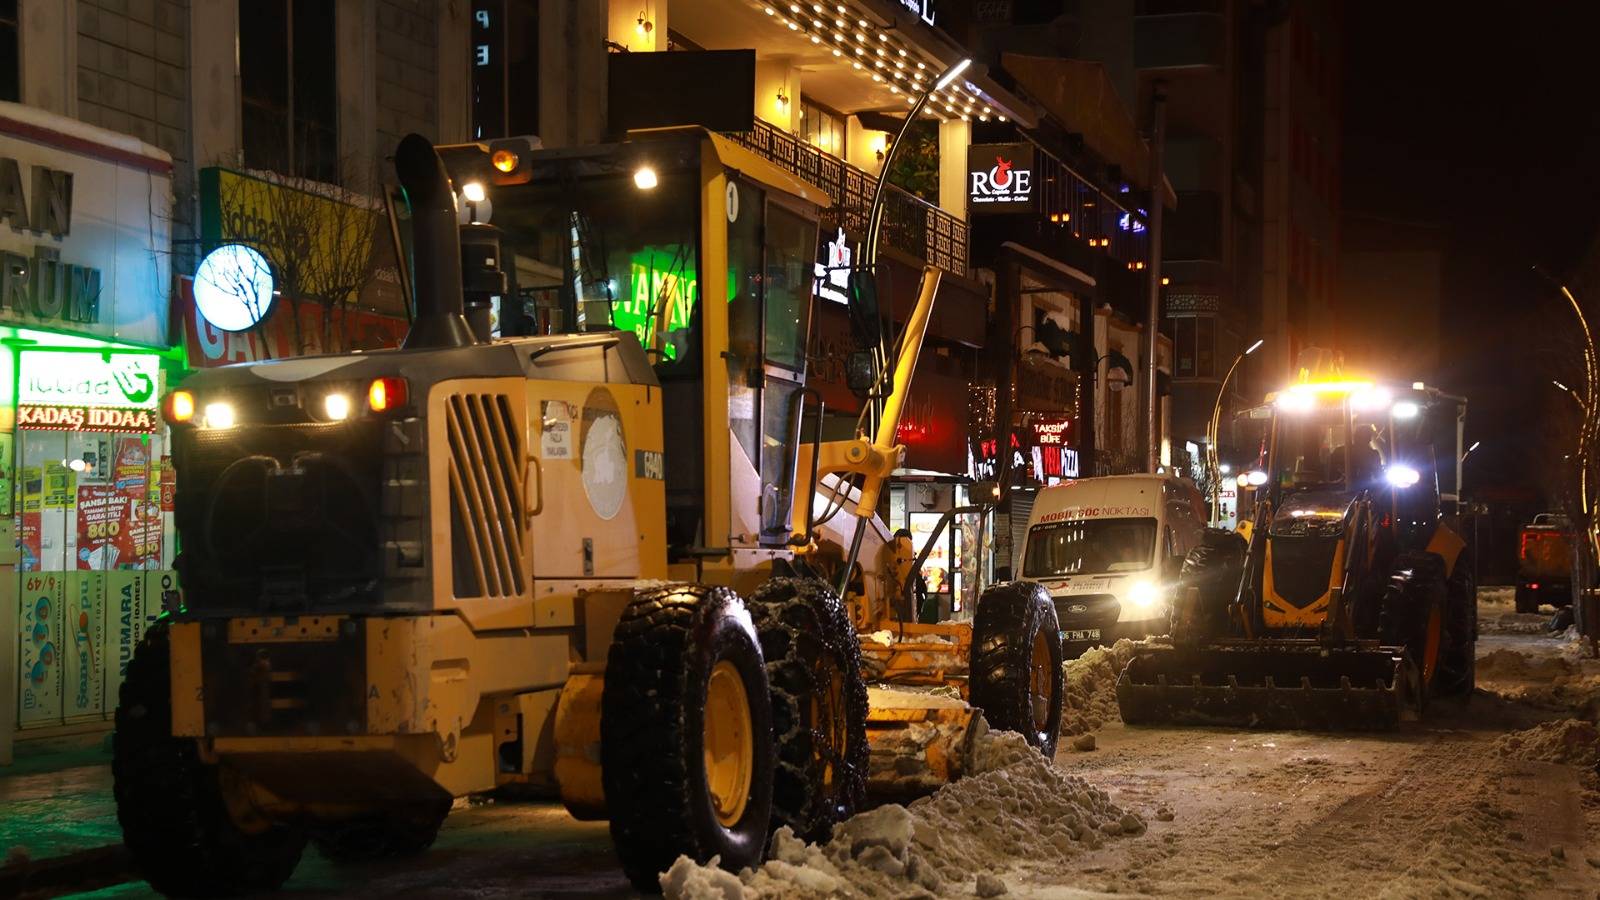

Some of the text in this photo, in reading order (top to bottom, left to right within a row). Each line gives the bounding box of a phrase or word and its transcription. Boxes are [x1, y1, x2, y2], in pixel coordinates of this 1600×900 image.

[19, 406, 150, 430] KADAŞ İDDAA
[1040, 433, 1061, 443] BÜFE
[87, 521, 120, 539] 800
[119, 584, 132, 677] NUMARA
